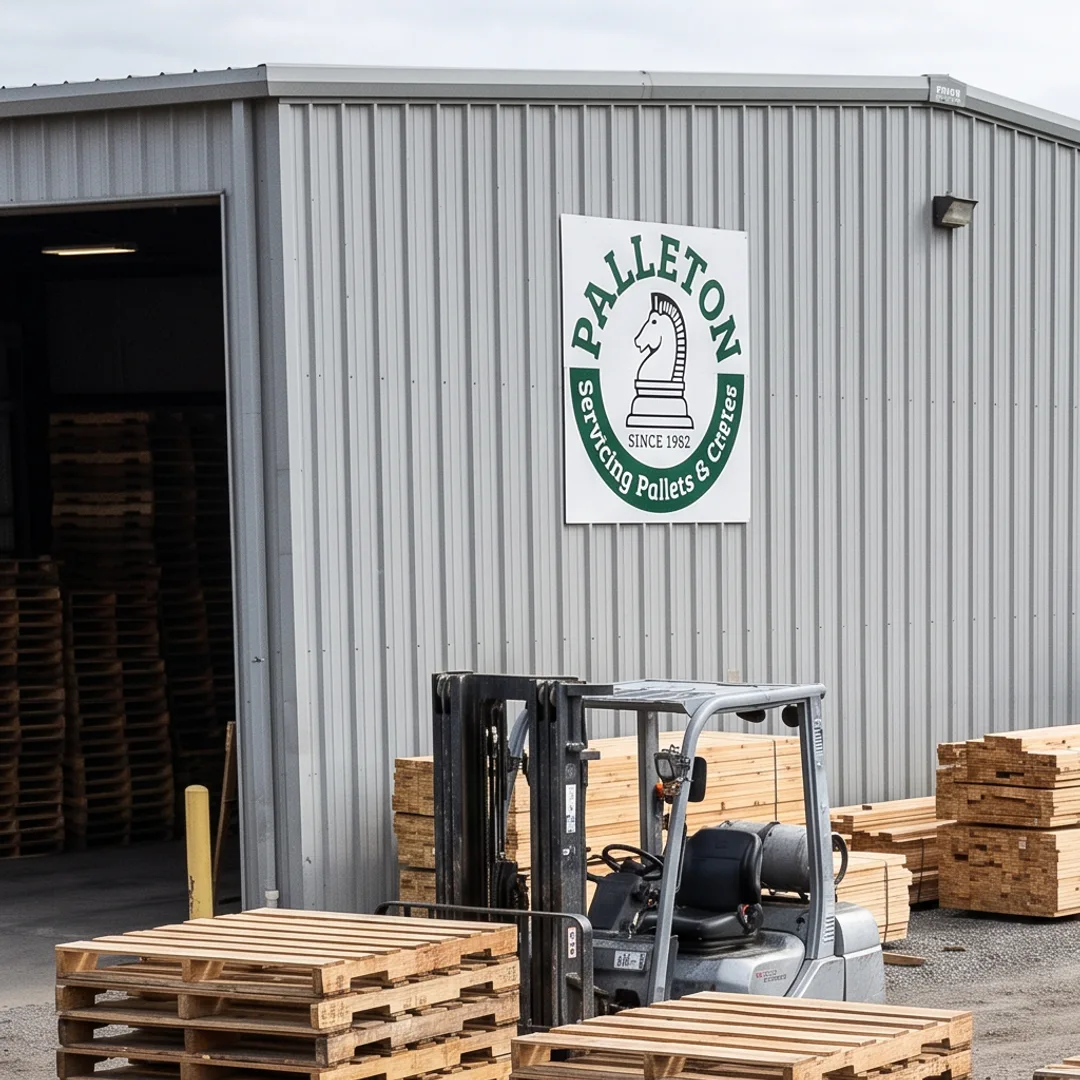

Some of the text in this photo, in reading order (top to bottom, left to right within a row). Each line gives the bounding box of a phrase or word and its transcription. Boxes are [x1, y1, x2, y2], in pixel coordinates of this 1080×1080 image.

[571, 234, 742, 363] PALLETON
[578, 380, 633, 495] Servicing
[635, 474, 695, 501] Pallets
[695, 459, 710, 481] &
[628, 434, 691, 449] SINCE 1982
